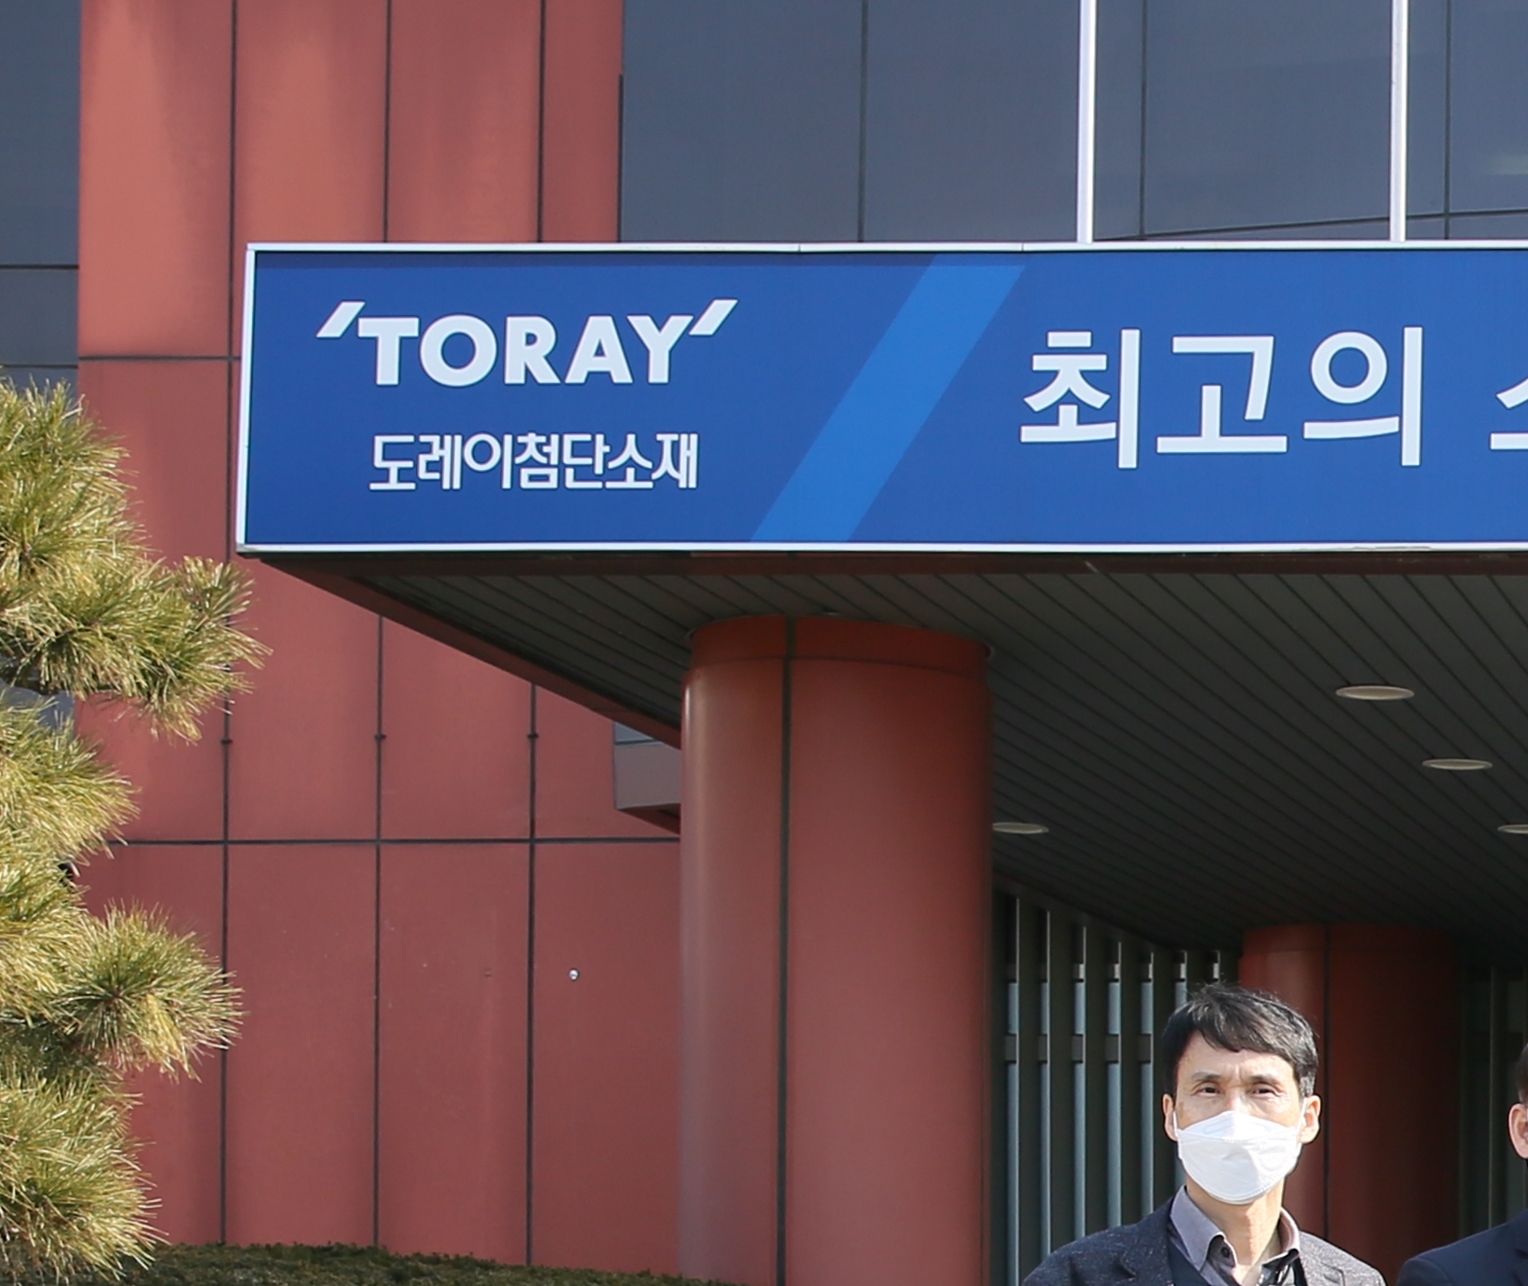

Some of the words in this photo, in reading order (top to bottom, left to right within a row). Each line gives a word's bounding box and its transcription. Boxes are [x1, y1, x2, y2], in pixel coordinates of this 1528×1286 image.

[316, 299, 738, 387] TORAY
[1020, 326, 1423, 469] 최고의
[369, 432, 699, 490] 도레이첨단소재
